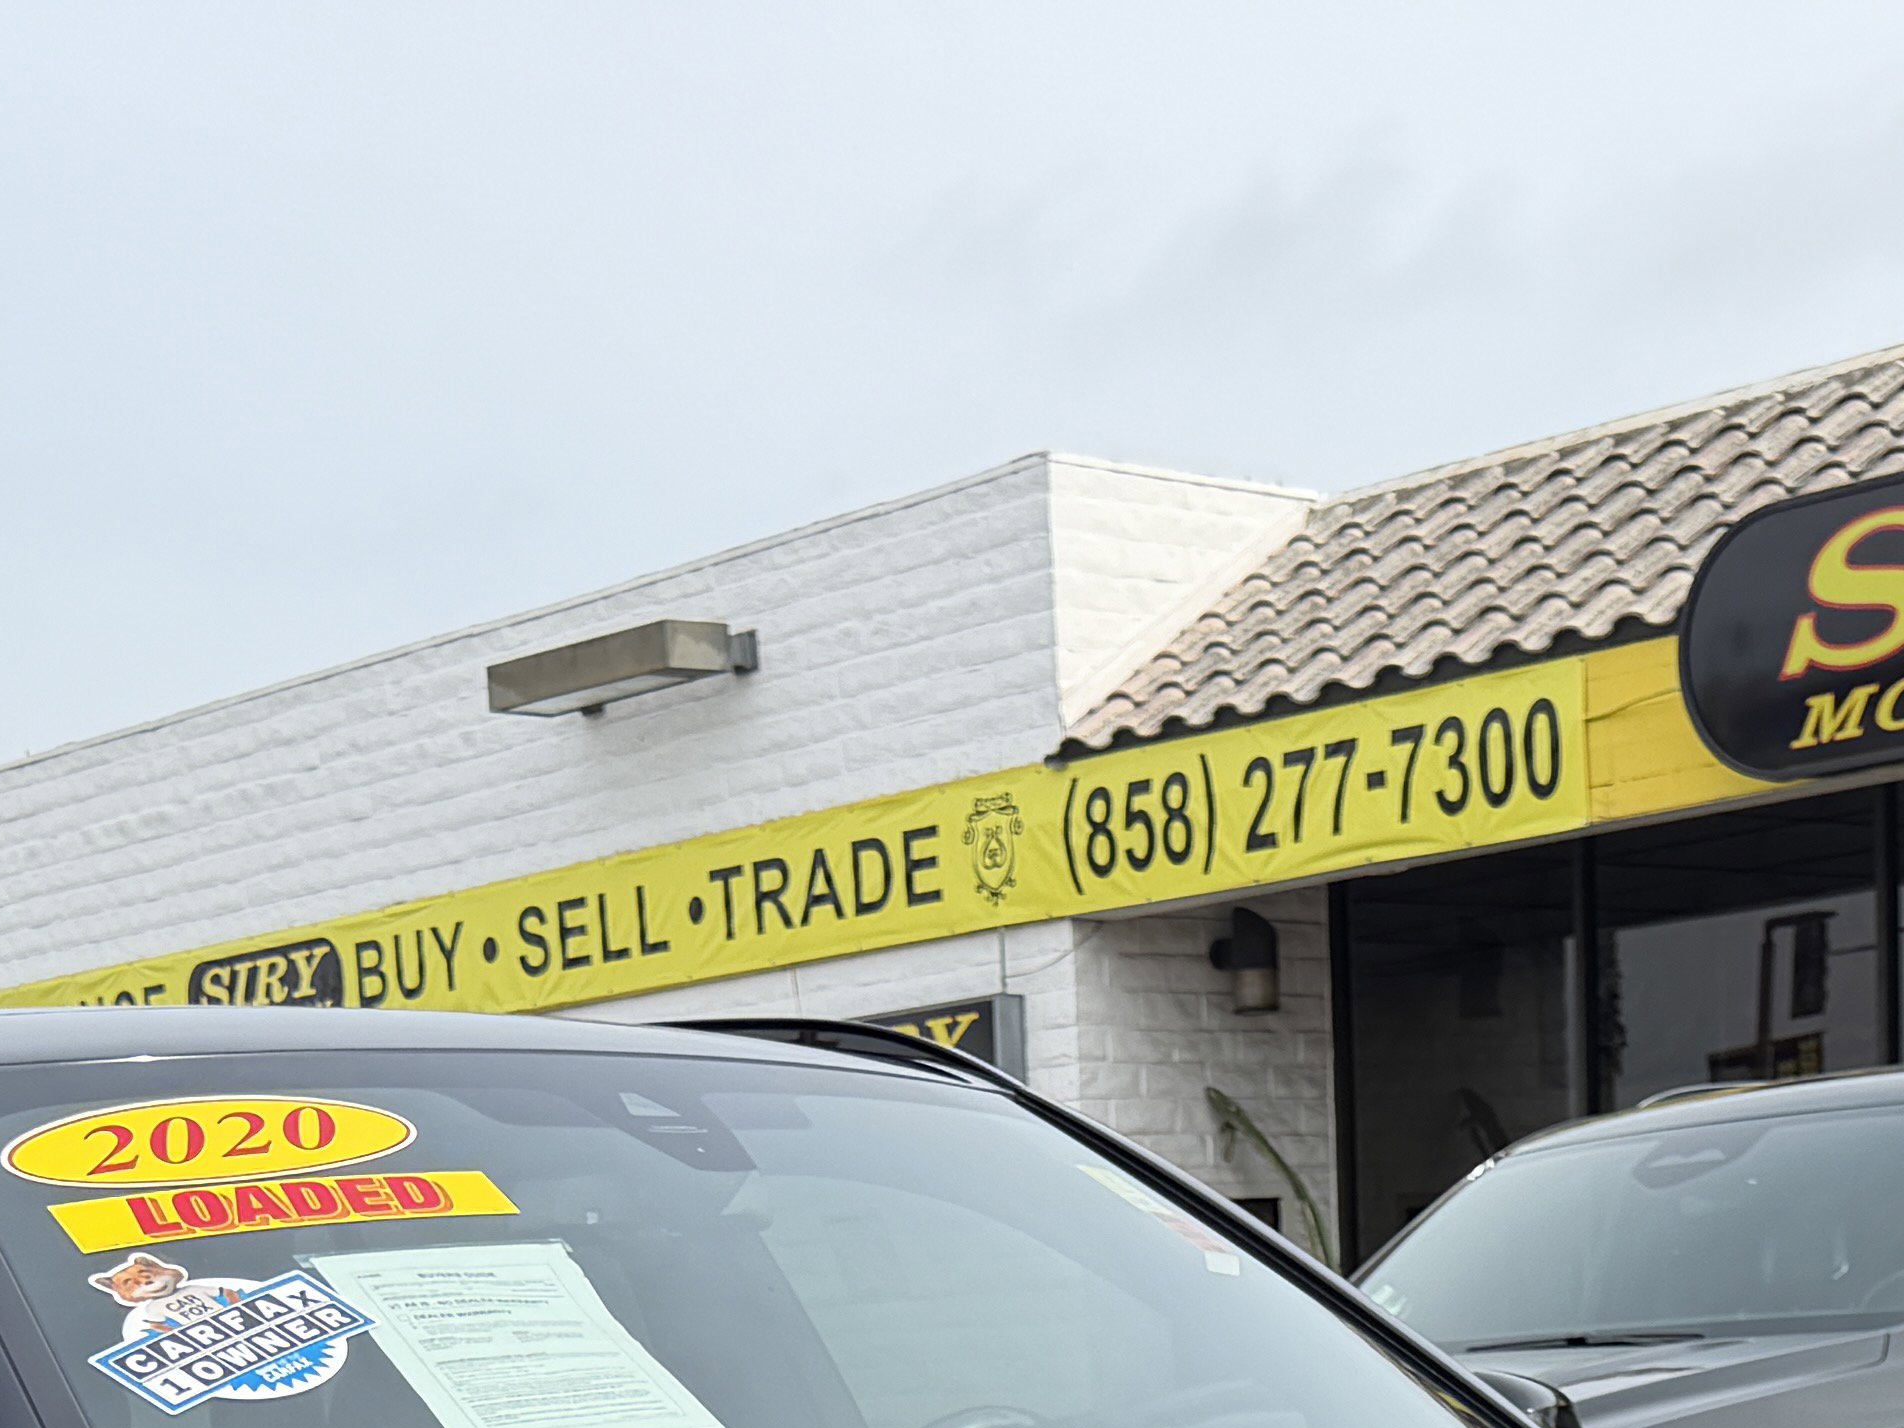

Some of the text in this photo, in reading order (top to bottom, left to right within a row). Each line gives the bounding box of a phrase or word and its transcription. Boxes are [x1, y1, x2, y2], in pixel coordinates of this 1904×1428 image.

[1062, 696, 1560, 895] (858) 277-7300
[353, 824, 944, 1008] BUY SELL TRADE
[200, 945, 331, 1006] SIRY
[83, 1105, 337, 1176] 2020
[127, 1174, 454, 1238] LOADED
[123, 1289, 322, 1374] CARFAX
[183, 1303, 215, 1321] FOX
[160, 1376, 194, 1397] 1
[190, 1306, 348, 1381] OWNER
